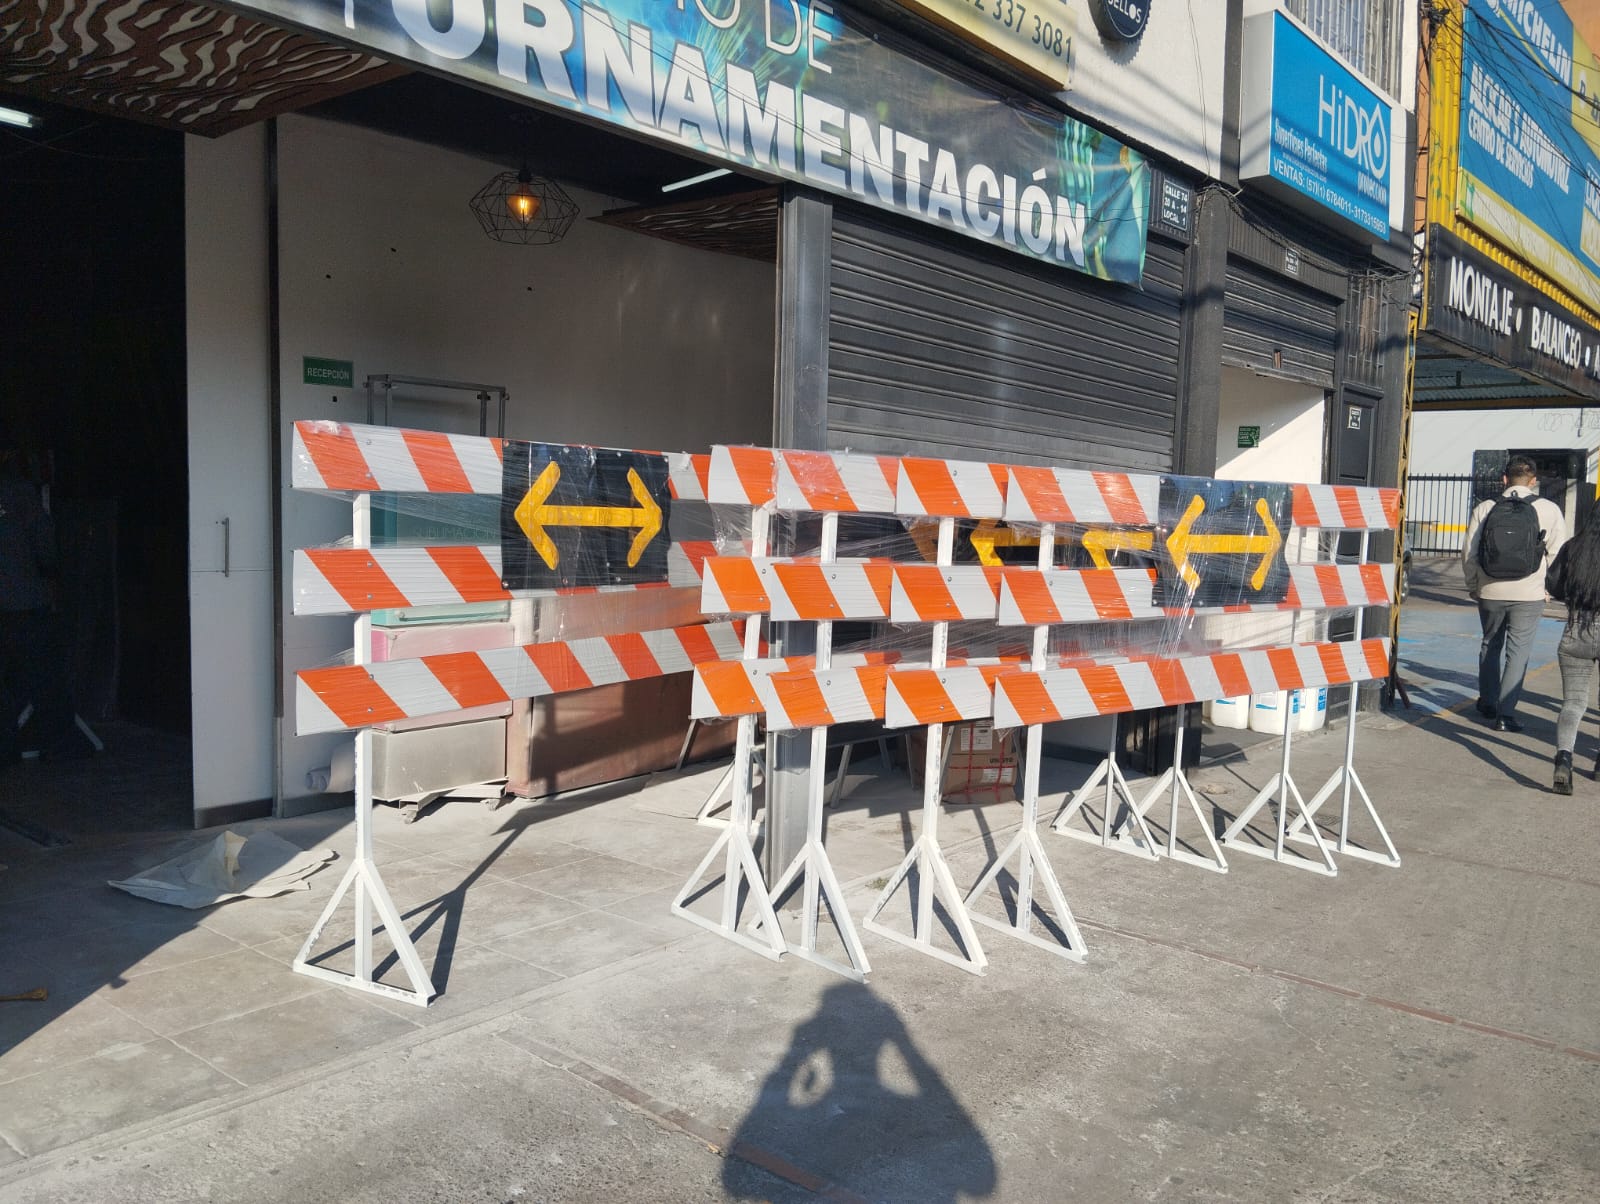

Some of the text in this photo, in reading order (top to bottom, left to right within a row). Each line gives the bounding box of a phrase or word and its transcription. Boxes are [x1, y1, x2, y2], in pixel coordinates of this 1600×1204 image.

[765, 0, 834, 74] DE
[992, 0, 1072, 63] 337 3081
[1468, 108, 1495, 156] CENTRO
[1495, 131, 1506, 165] DE
[1165, 184, 1181, 200] CALLE
[1273, 155, 1306, 188] VENTAS:
[1164, 209, 1180, 223] LOCAL
[1449, 256, 1514, 337] MONTAJE
[1531, 306, 1582, 369] BALANCEO
